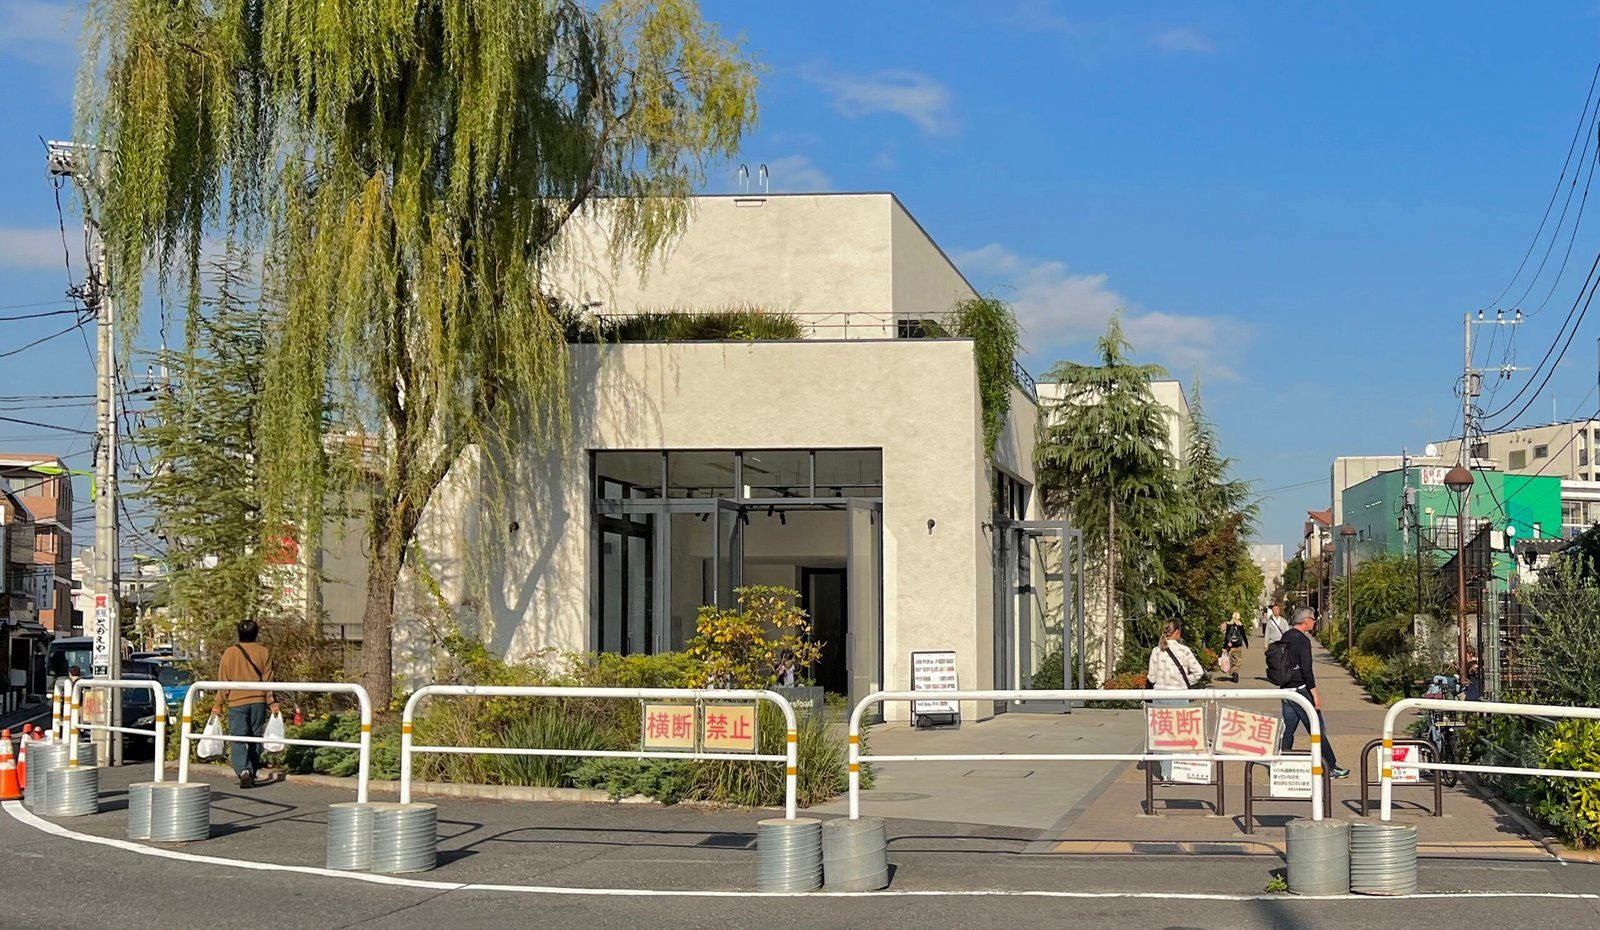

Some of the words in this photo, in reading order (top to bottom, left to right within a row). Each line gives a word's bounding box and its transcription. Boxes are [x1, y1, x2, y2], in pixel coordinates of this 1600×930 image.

[647, 712, 692, 739] 横断
[706, 713, 752, 740] 禁止
[1149, 708, 1201, 736] 横断
[1220, 710, 1276, 745] 歩道
